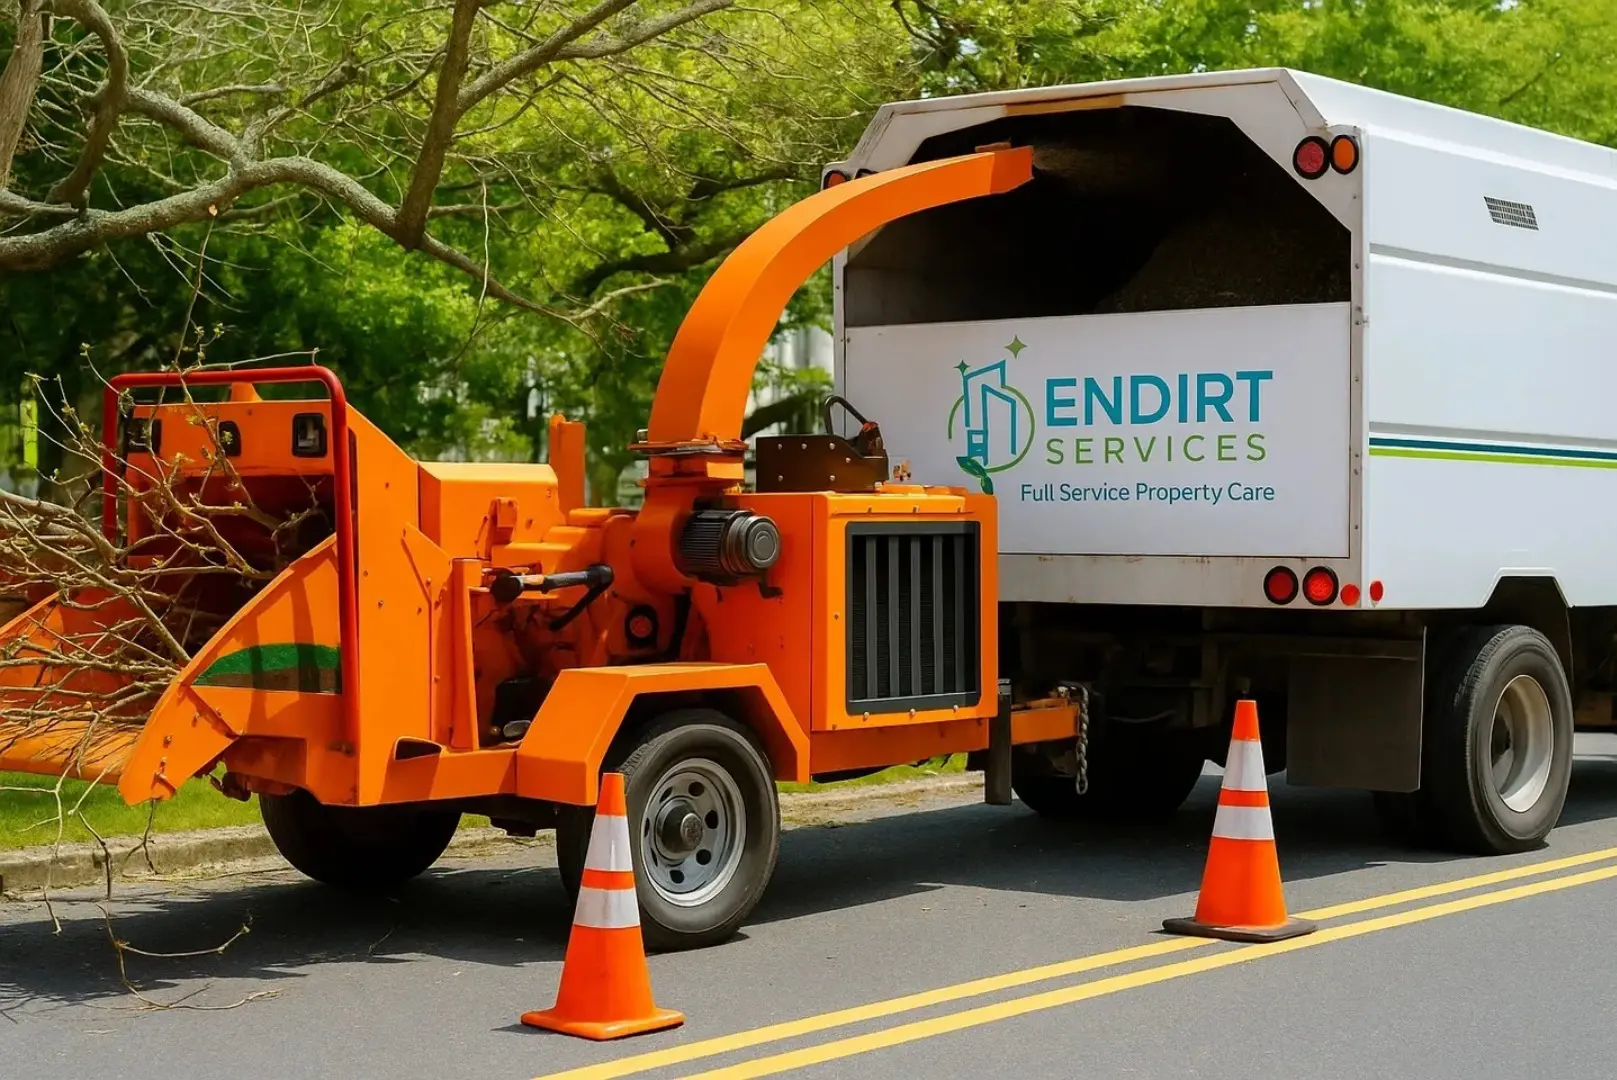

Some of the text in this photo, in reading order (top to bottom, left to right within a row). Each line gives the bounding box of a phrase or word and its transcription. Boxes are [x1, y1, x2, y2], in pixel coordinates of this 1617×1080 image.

[1045, 370, 1274, 427] ENDIRT
[1046, 433, 1267, 465] SERVICES
[1021, 482, 1275, 505] Full Service Property Care
